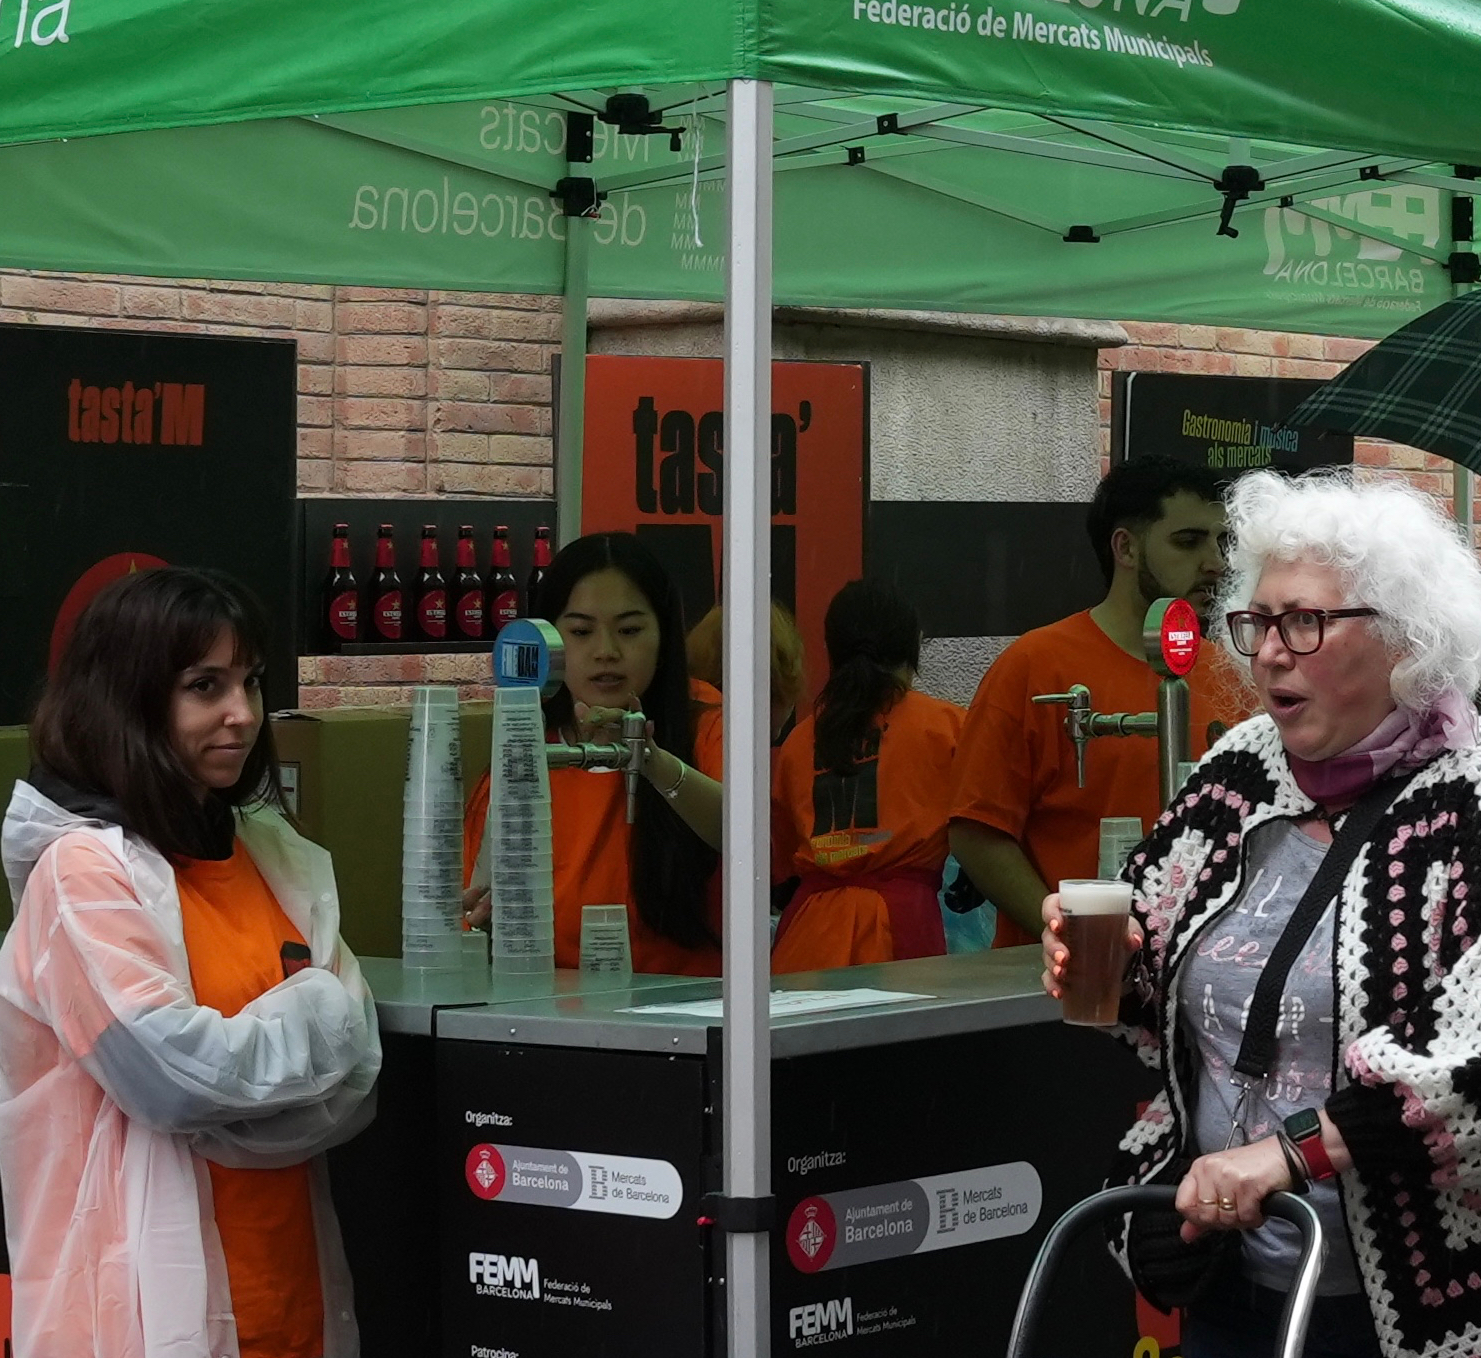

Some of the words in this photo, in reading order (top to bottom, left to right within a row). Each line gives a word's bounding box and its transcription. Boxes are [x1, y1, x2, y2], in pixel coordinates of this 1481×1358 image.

[977, 12, 1007, 39] de
[1012, 12, 1101, 51] Mercats
[1104, 25, 1214, 68] Municipals
[68, 378, 206, 446] tasta'M
[1182, 409, 1252, 445] Gastronomia
[632, 396, 812, 516] tasa'
[1207, 442, 1225, 468] als
[1227, 444, 1272, 468] mercats
[465, 1110, 513, 1127] Organitza:
[512, 1159, 557, 1174] Ajuntament
[558, 1163, 569, 1175] de
[787, 1150, 846, 1175] Organitza:
[512, 1174, 569, 1192] Barcelona
[611, 1171, 647, 1186] Mercats
[611, 1187, 623, 1199] de
[626, 1188, 670, 1204] Barcelona
[963, 1186, 1002, 1206] Mercats
[845, 1201, 899, 1223] Ajuntament
[902, 1199, 913, 1211] de
[963, 1211, 976, 1225] de
[979, 1202, 1028, 1222] Barcelona
[845, 1218, 914, 1244] Barcelona
[469, 1252, 540, 1299] FEMM
[543, 1278, 579, 1292] Federació
[580, 1282, 591, 1294] de
[476, 1284, 534, 1301] BARCELONA
[543, 1293, 572, 1306] Mercats
[573, 1296, 613, 1311] Municipals
[789, 1296, 853, 1340] FEMM
[795, 1329, 848, 1349] BARCELONA
